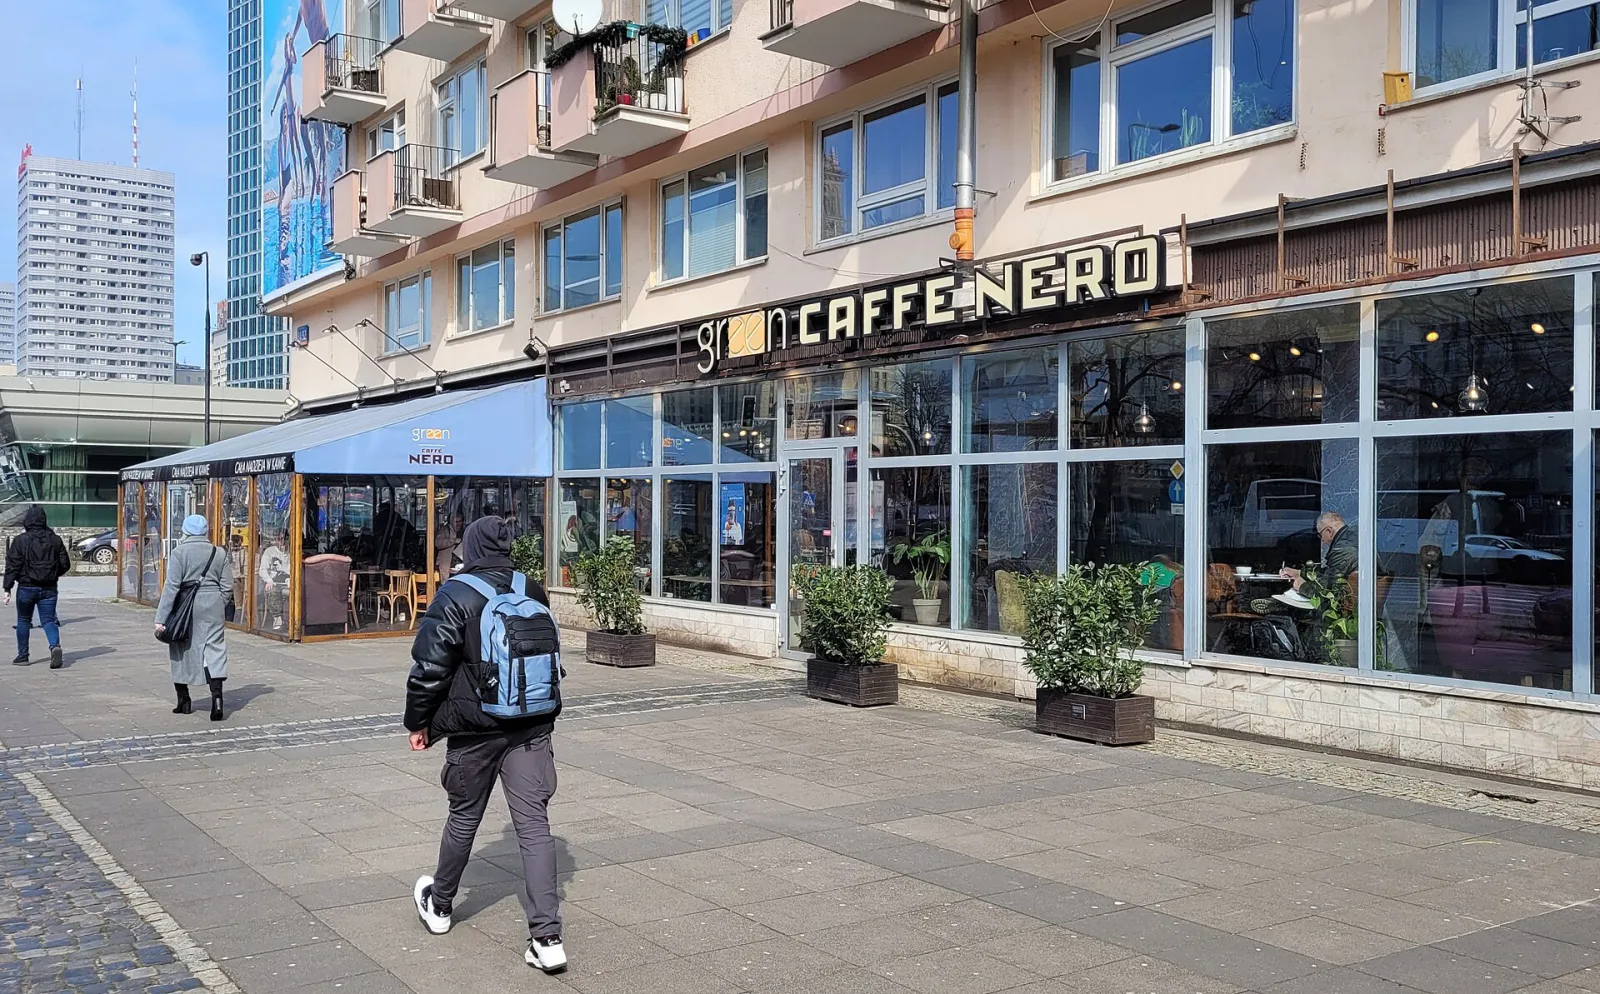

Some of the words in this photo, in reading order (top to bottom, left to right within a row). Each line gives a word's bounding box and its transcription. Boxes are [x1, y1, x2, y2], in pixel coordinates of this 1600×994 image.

[697, 308, 787, 374] green
[975, 236, 1159, 318] NERO
[412, 428, 451, 442] green
[409, 454, 454, 465] NERO
